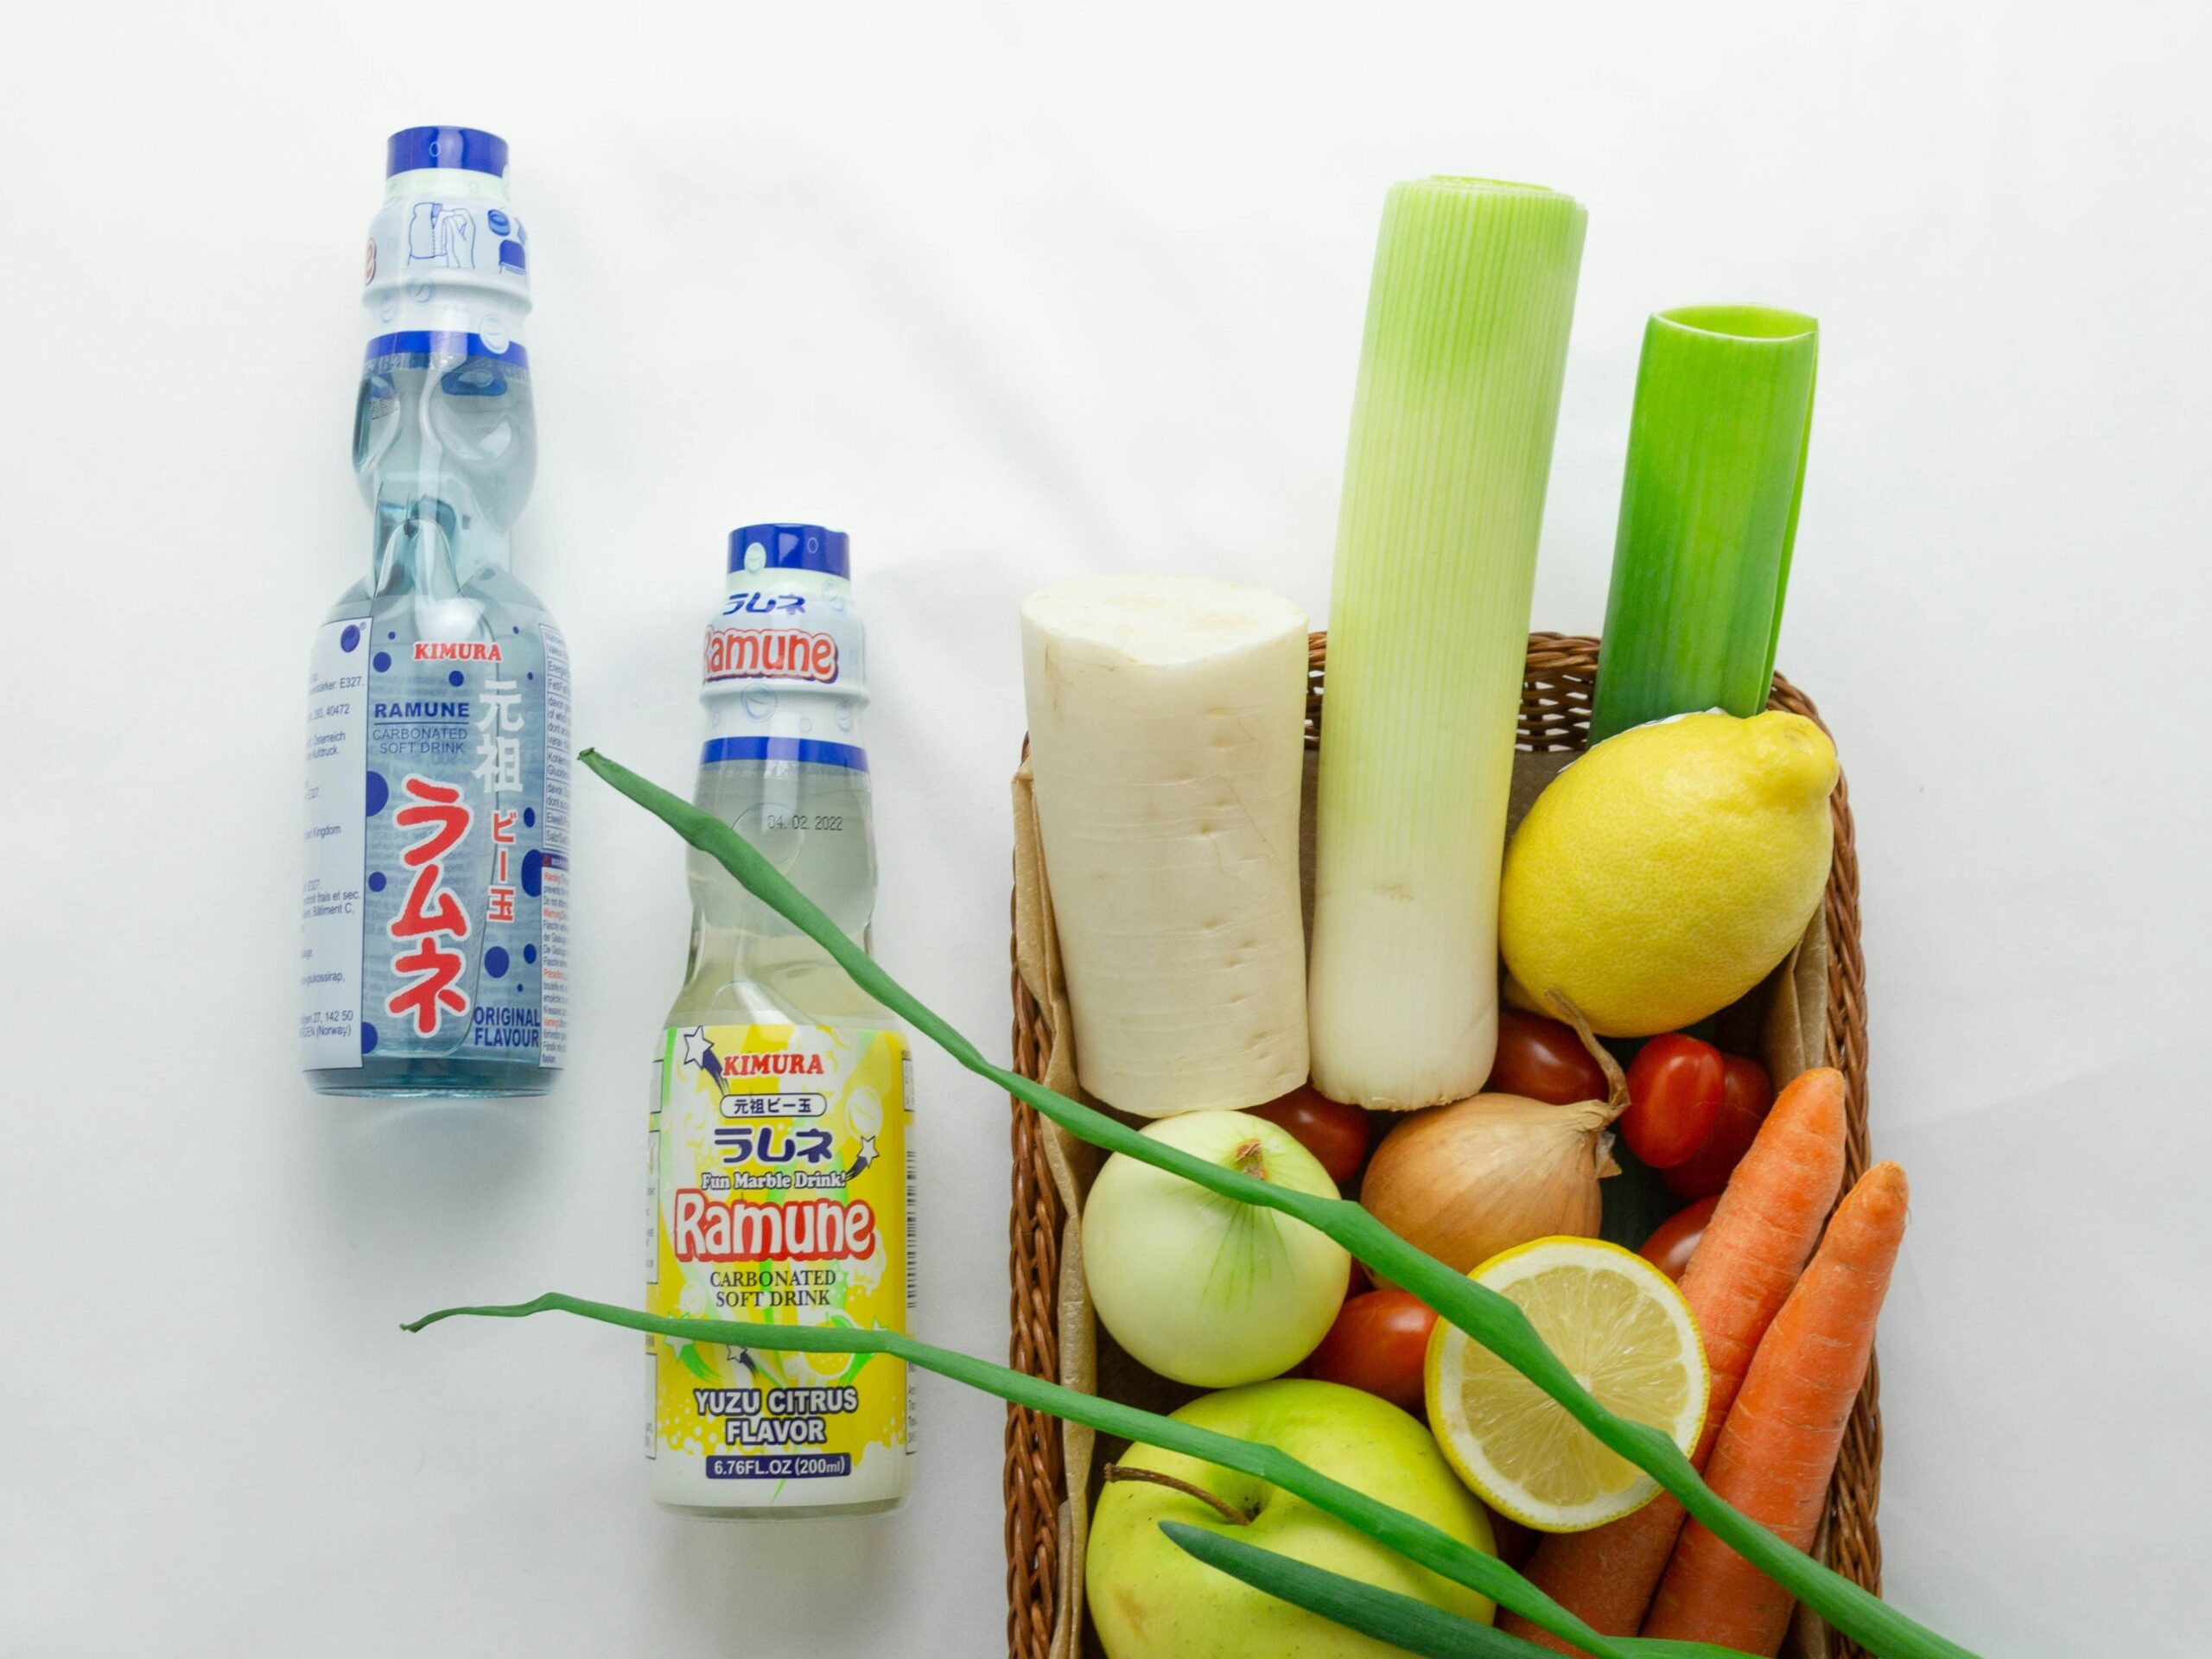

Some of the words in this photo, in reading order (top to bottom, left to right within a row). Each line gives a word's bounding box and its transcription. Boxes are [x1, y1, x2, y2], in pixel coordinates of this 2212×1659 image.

[722, 592, 806, 616] ラムネ
[414, 643, 503, 662] KIMURA
[374, 702, 470, 719] RAMUNE
[372, 728, 468, 741] CARBONATED
[471, 680, 524, 793] 元祖
[380, 742, 416, 754] SOFT
[420, 742, 465, 754] DRINK
[815, 816, 843, 831] 2022
[486, 811, 518, 923] ビー玉
[386, 775, 471, 1036] ラムネ
[325, 1009, 340, 1022] 142
[341, 1009, 353, 1021] 50
[474, 1006, 541, 1028] ORIGINAL
[474, 1027, 540, 1048] FLAVOUR
[722, 1053, 825, 1077] KIMURA
[734, 1097, 812, 1116] 元祖ビー玉
[714, 1127, 834, 1164] ラムネ
[701, 1172, 731, 1191] Fun
[734, 1170, 792, 1190] Marble
[794, 1170, 847, 1189] Drink!
[676, 1191, 874, 1259] Ramune
[709, 1269, 836, 1287] CARBONATED
[715, 1290, 767, 1307] SOFT
[769, 1289, 831, 1306] DRINK
[694, 1389, 762, 1415] YUZU
[766, 1387, 859, 1414] CITRUS
[725, 1418, 827, 1445] FLAVOR
[713, 1459, 793, 1476] 6.76FL.OZ
[794, 1455, 846, 1477] (200ml)
